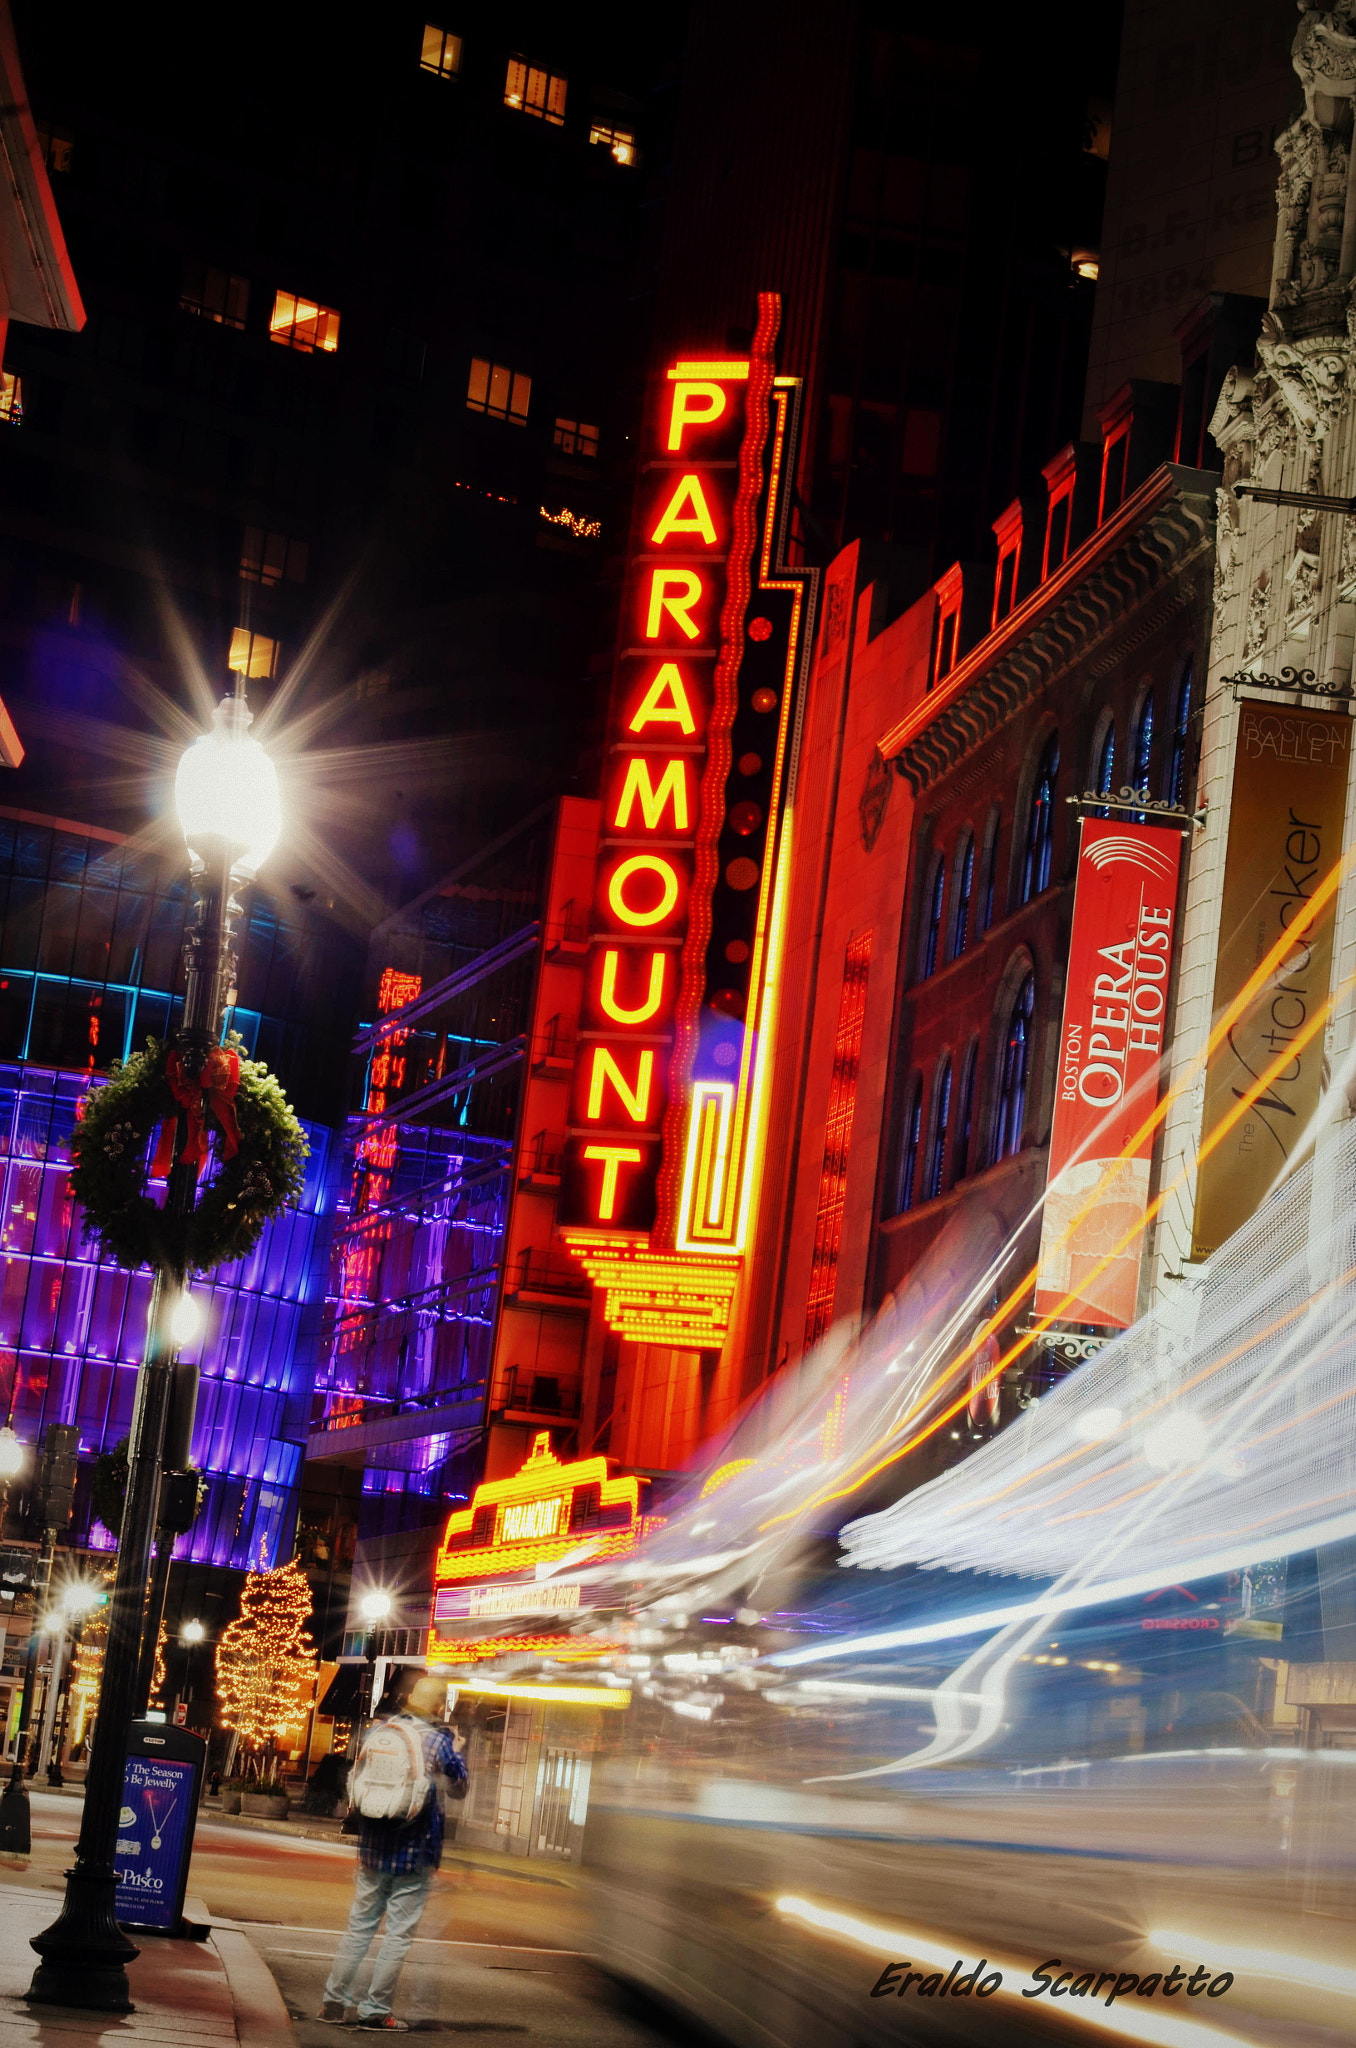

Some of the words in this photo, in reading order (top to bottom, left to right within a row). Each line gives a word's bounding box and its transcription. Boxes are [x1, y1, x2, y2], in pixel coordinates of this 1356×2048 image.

[1242, 712, 1347, 750] BOSTON
[1245, 728, 1341, 764] BALLET
[582, 381, 727, 1220] PARAMOUNT
[1129, 904, 1173, 1054] HOUSE
[1078, 936, 1137, 1108] OPERA
[1061, 1023, 1084, 1103] BOSTON
[1237, 1122, 1255, 1155] The
[130, 1774, 143, 1785] Be
[143, 1776, 177, 1791] Jewelly
[132, 1763, 151, 1775] The
[151, 1766, 184, 1779] Season
